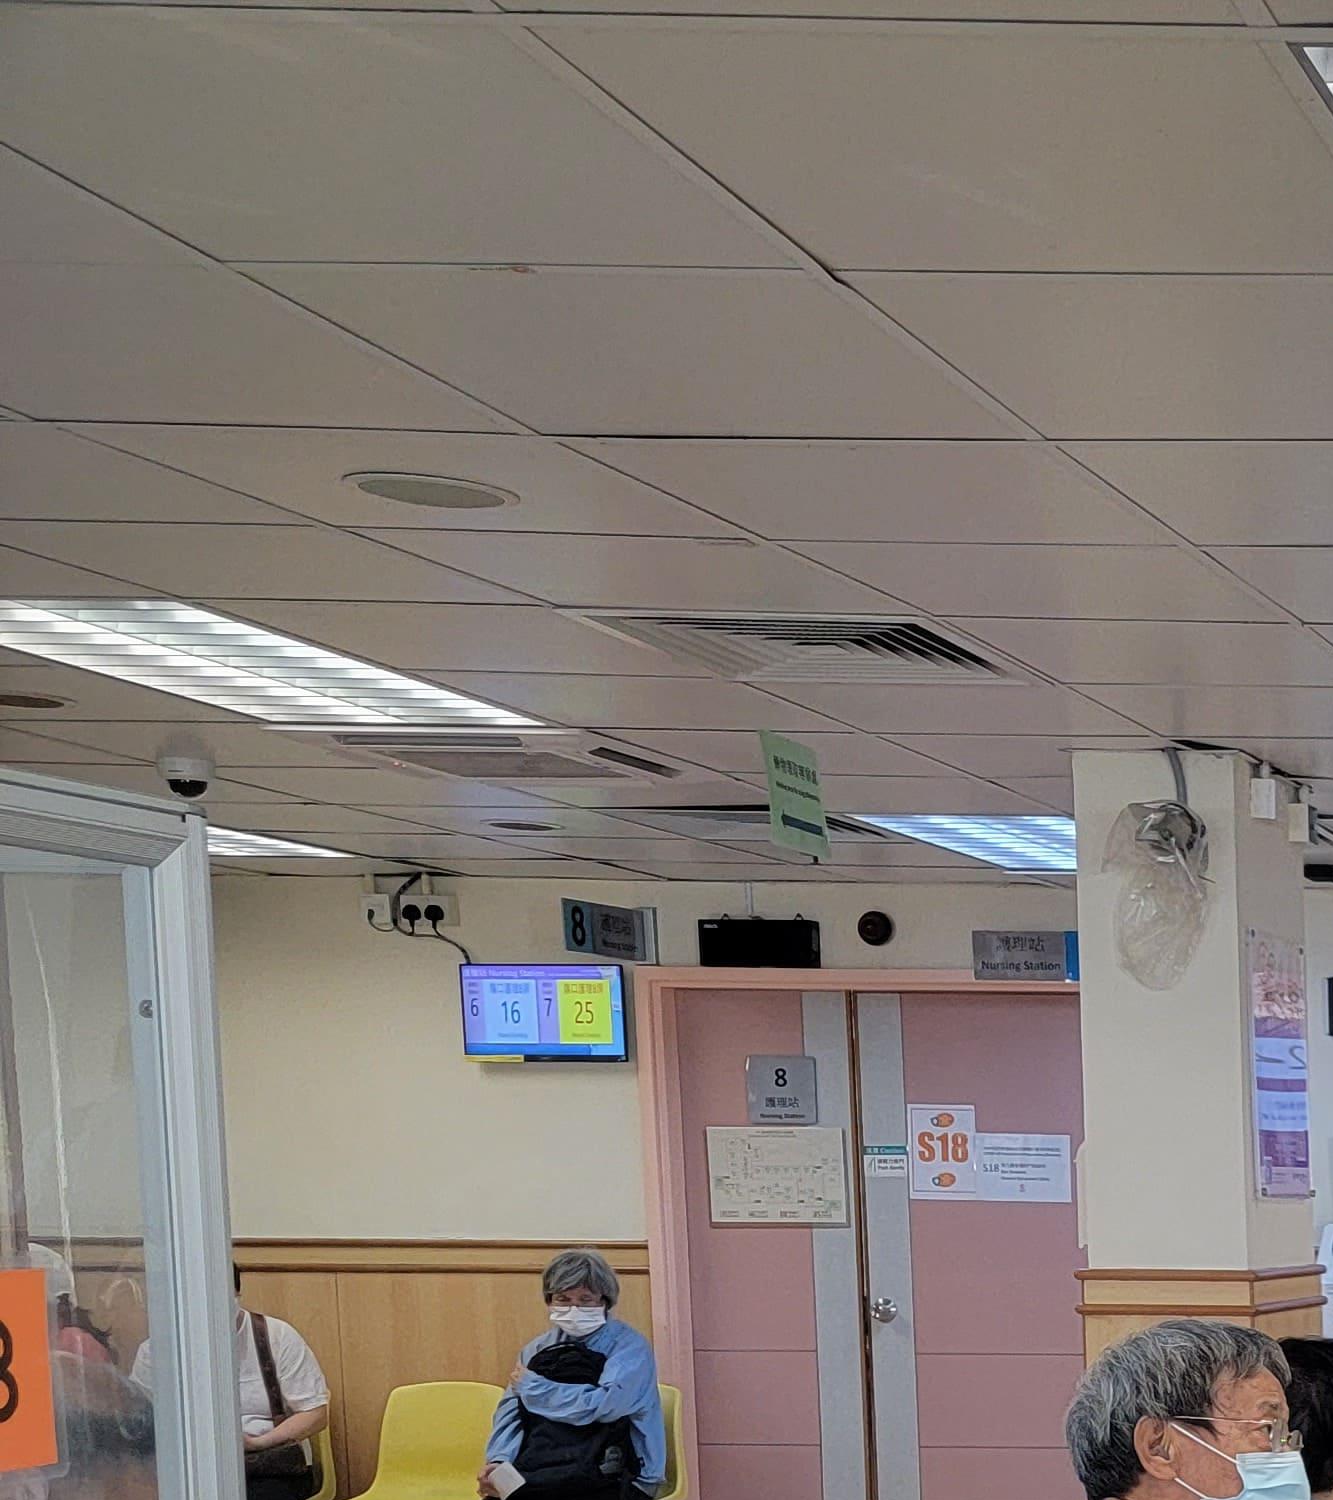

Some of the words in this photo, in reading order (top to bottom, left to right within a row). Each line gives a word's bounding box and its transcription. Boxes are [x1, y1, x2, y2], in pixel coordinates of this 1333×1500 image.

[571, 905, 586, 947] 8
[981, 959, 1022, 973] Nursing
[1023, 959, 1062, 972] Station
[469, 998, 480, 1017] 6
[500, 1000, 522, 1025] 16
[543, 998, 553, 1017] 7
[573, 1000, 596, 1025] 25
[774, 1067, 788, 1088] 8
[916, 1130, 970, 1163] S18
